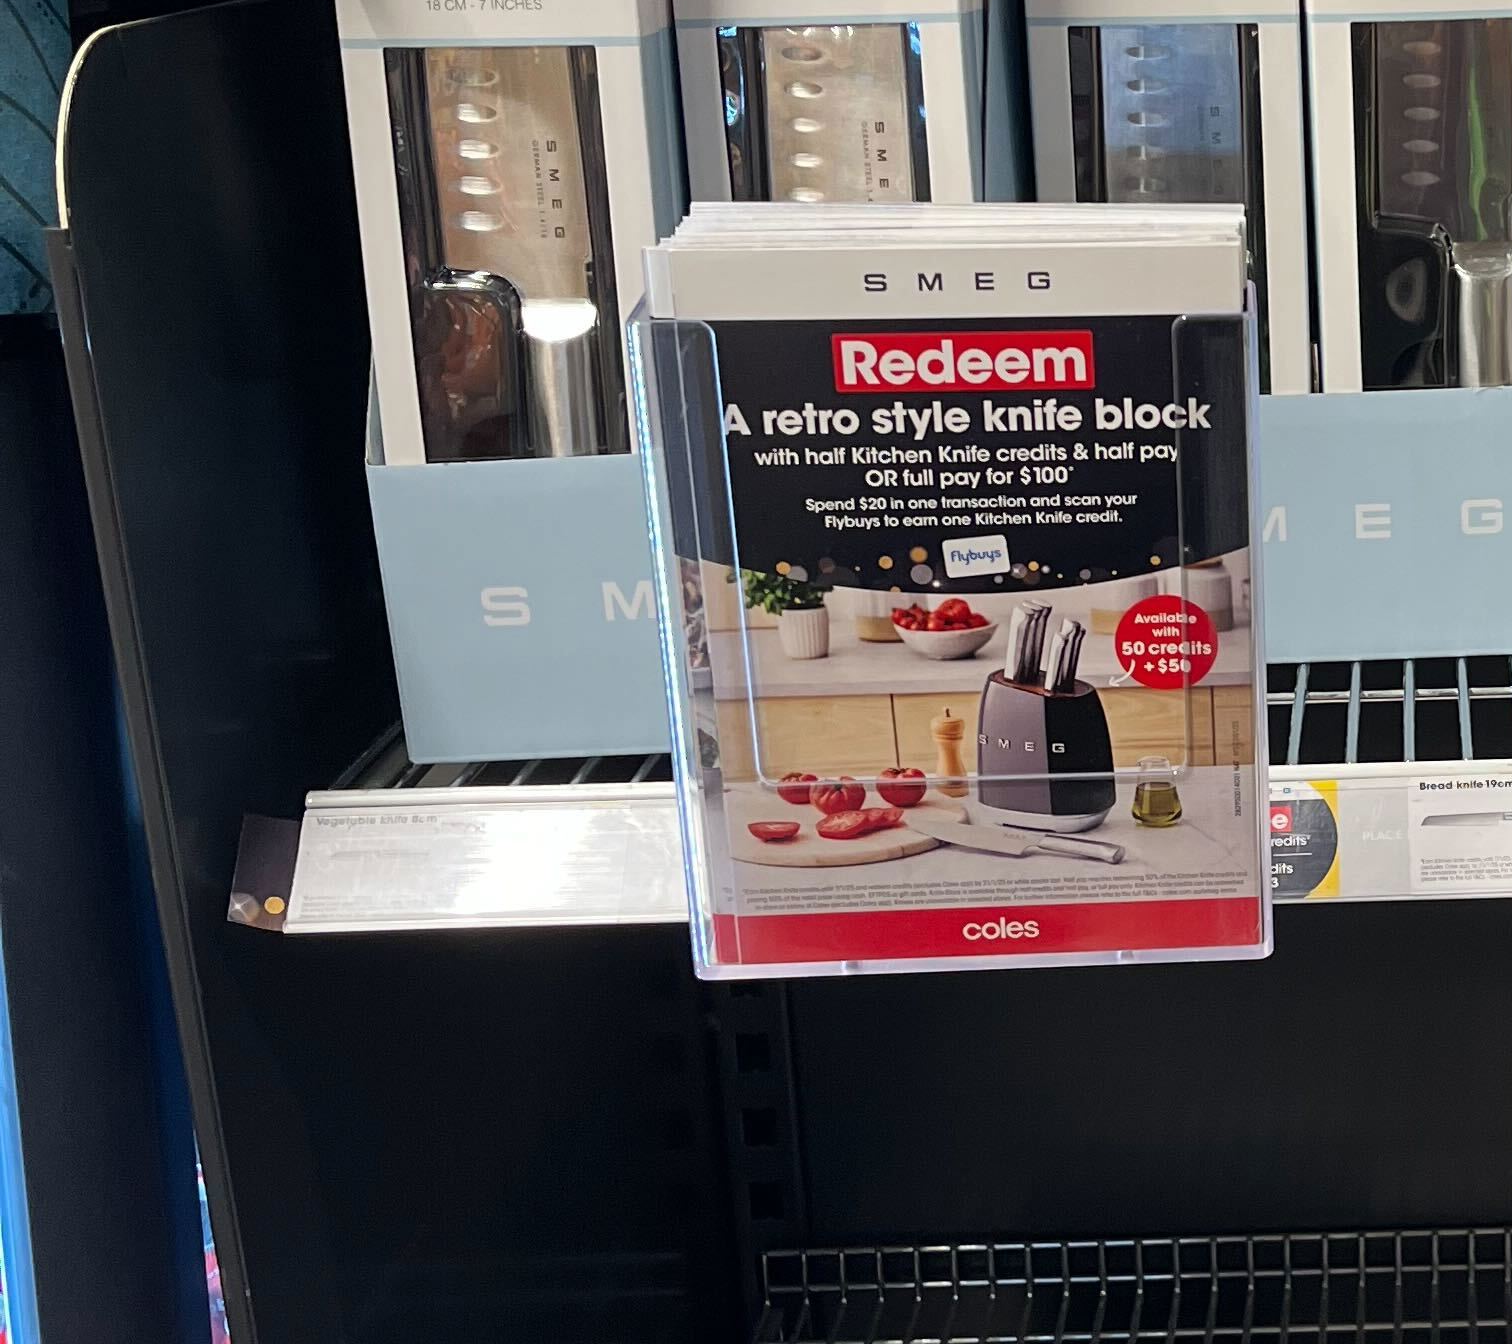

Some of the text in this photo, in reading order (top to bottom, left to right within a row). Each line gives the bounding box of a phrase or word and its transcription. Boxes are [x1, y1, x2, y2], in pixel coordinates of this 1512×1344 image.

[426, 0, 440, 11] 18
[444, 0, 467, 11] CM
[480, 0, 486, 11] 7
[546, 139, 566, 239] SMEG
[864, 272, 1051, 293] SMEG
[841, 339, 1087, 386] Redeem
[724, 397, 1211, 441] A retro style knife block
[754, 441, 1179, 466] with half Kitchen Knife credits & half pay
[865, 469, 898, 487] OR
[903, 467, 935, 486] full
[940, 470, 981, 490] pay
[986, 466, 1015, 485] for
[806, 493, 1138, 513] Spend $20 in one transaction and scan your
[824, 509, 1123, 531] Flybuys to earn one Kitchen Knife credit.
[1260, 499, 1504, 542] MEG
[950, 545, 1003, 564] flybuys
[1134, 613, 1197, 624] Available
[1151, 626, 1180, 637] with
[1121, 641, 1212, 656] 50 credits
[1158, 657, 1191, 674] $50
[979, 733, 1066, 754] SMEG
[1419, 781, 1453, 791] Bread
[1456, 780, 1484, 790] knife
[962, 916, 1040, 941] coles
